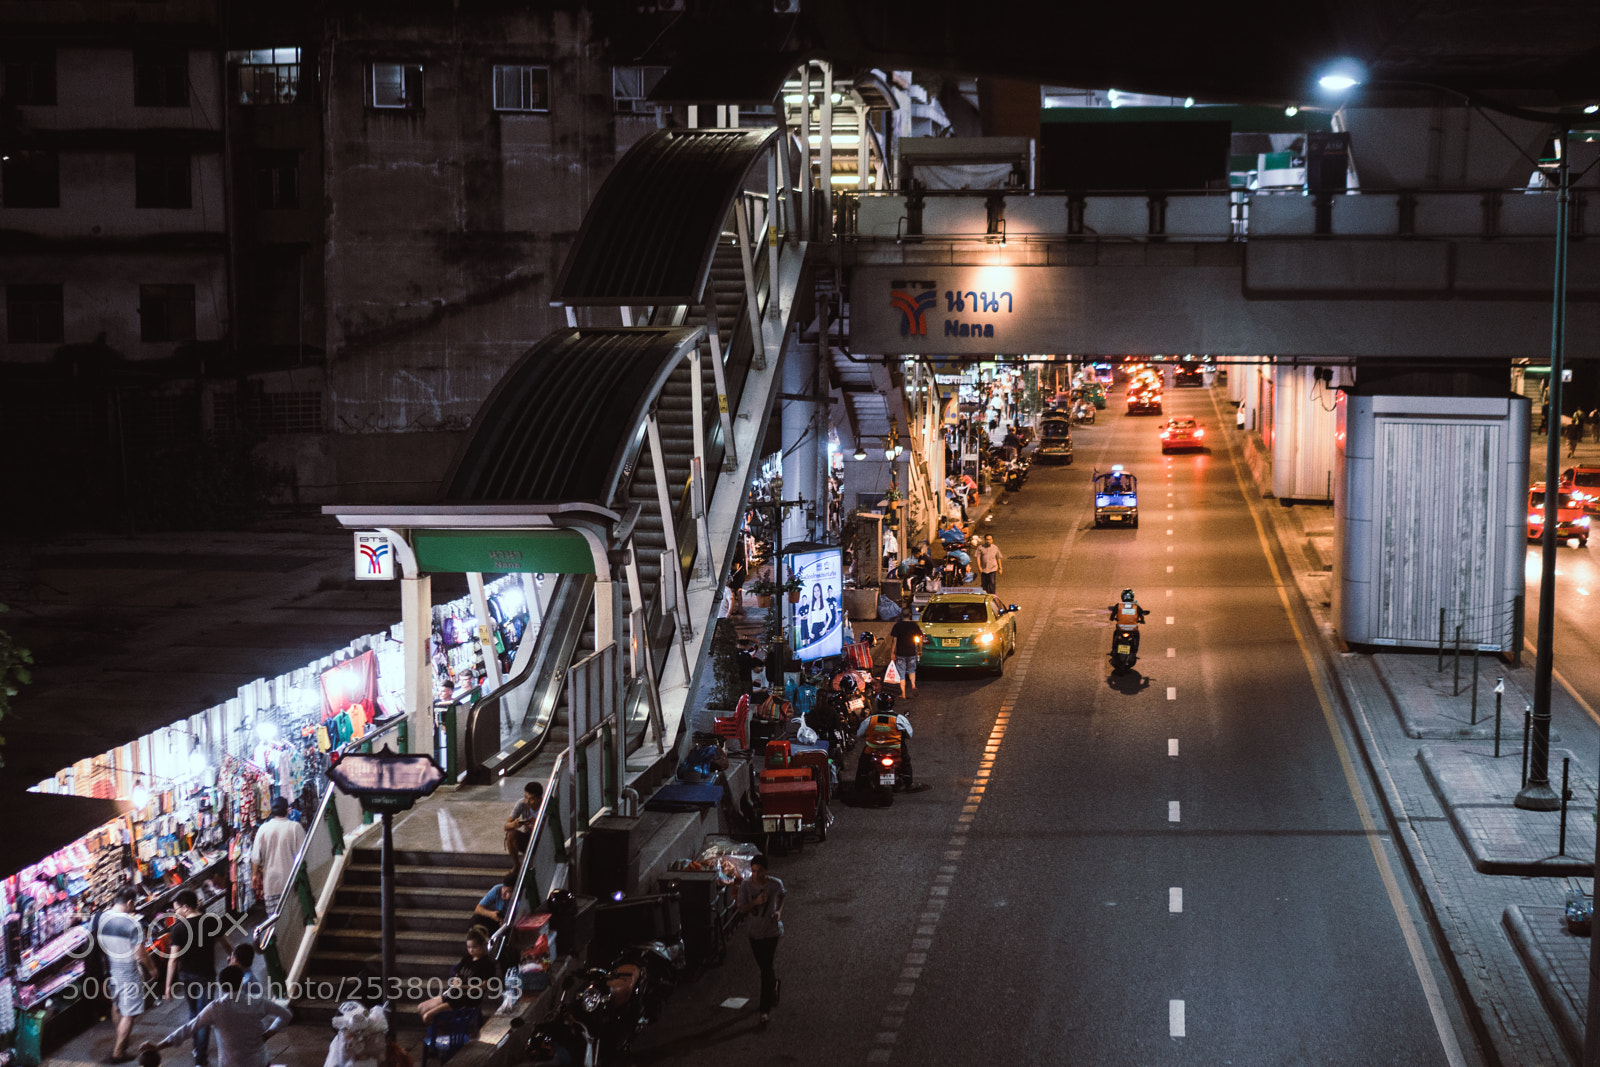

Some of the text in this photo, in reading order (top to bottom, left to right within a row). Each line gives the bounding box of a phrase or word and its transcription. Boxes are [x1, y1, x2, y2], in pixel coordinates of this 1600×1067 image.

[945, 290, 1013, 313] นานา
[944, 319, 994, 338] Nana
[488, 550, 523, 560] นานา
[494, 561, 521, 569] Nana
